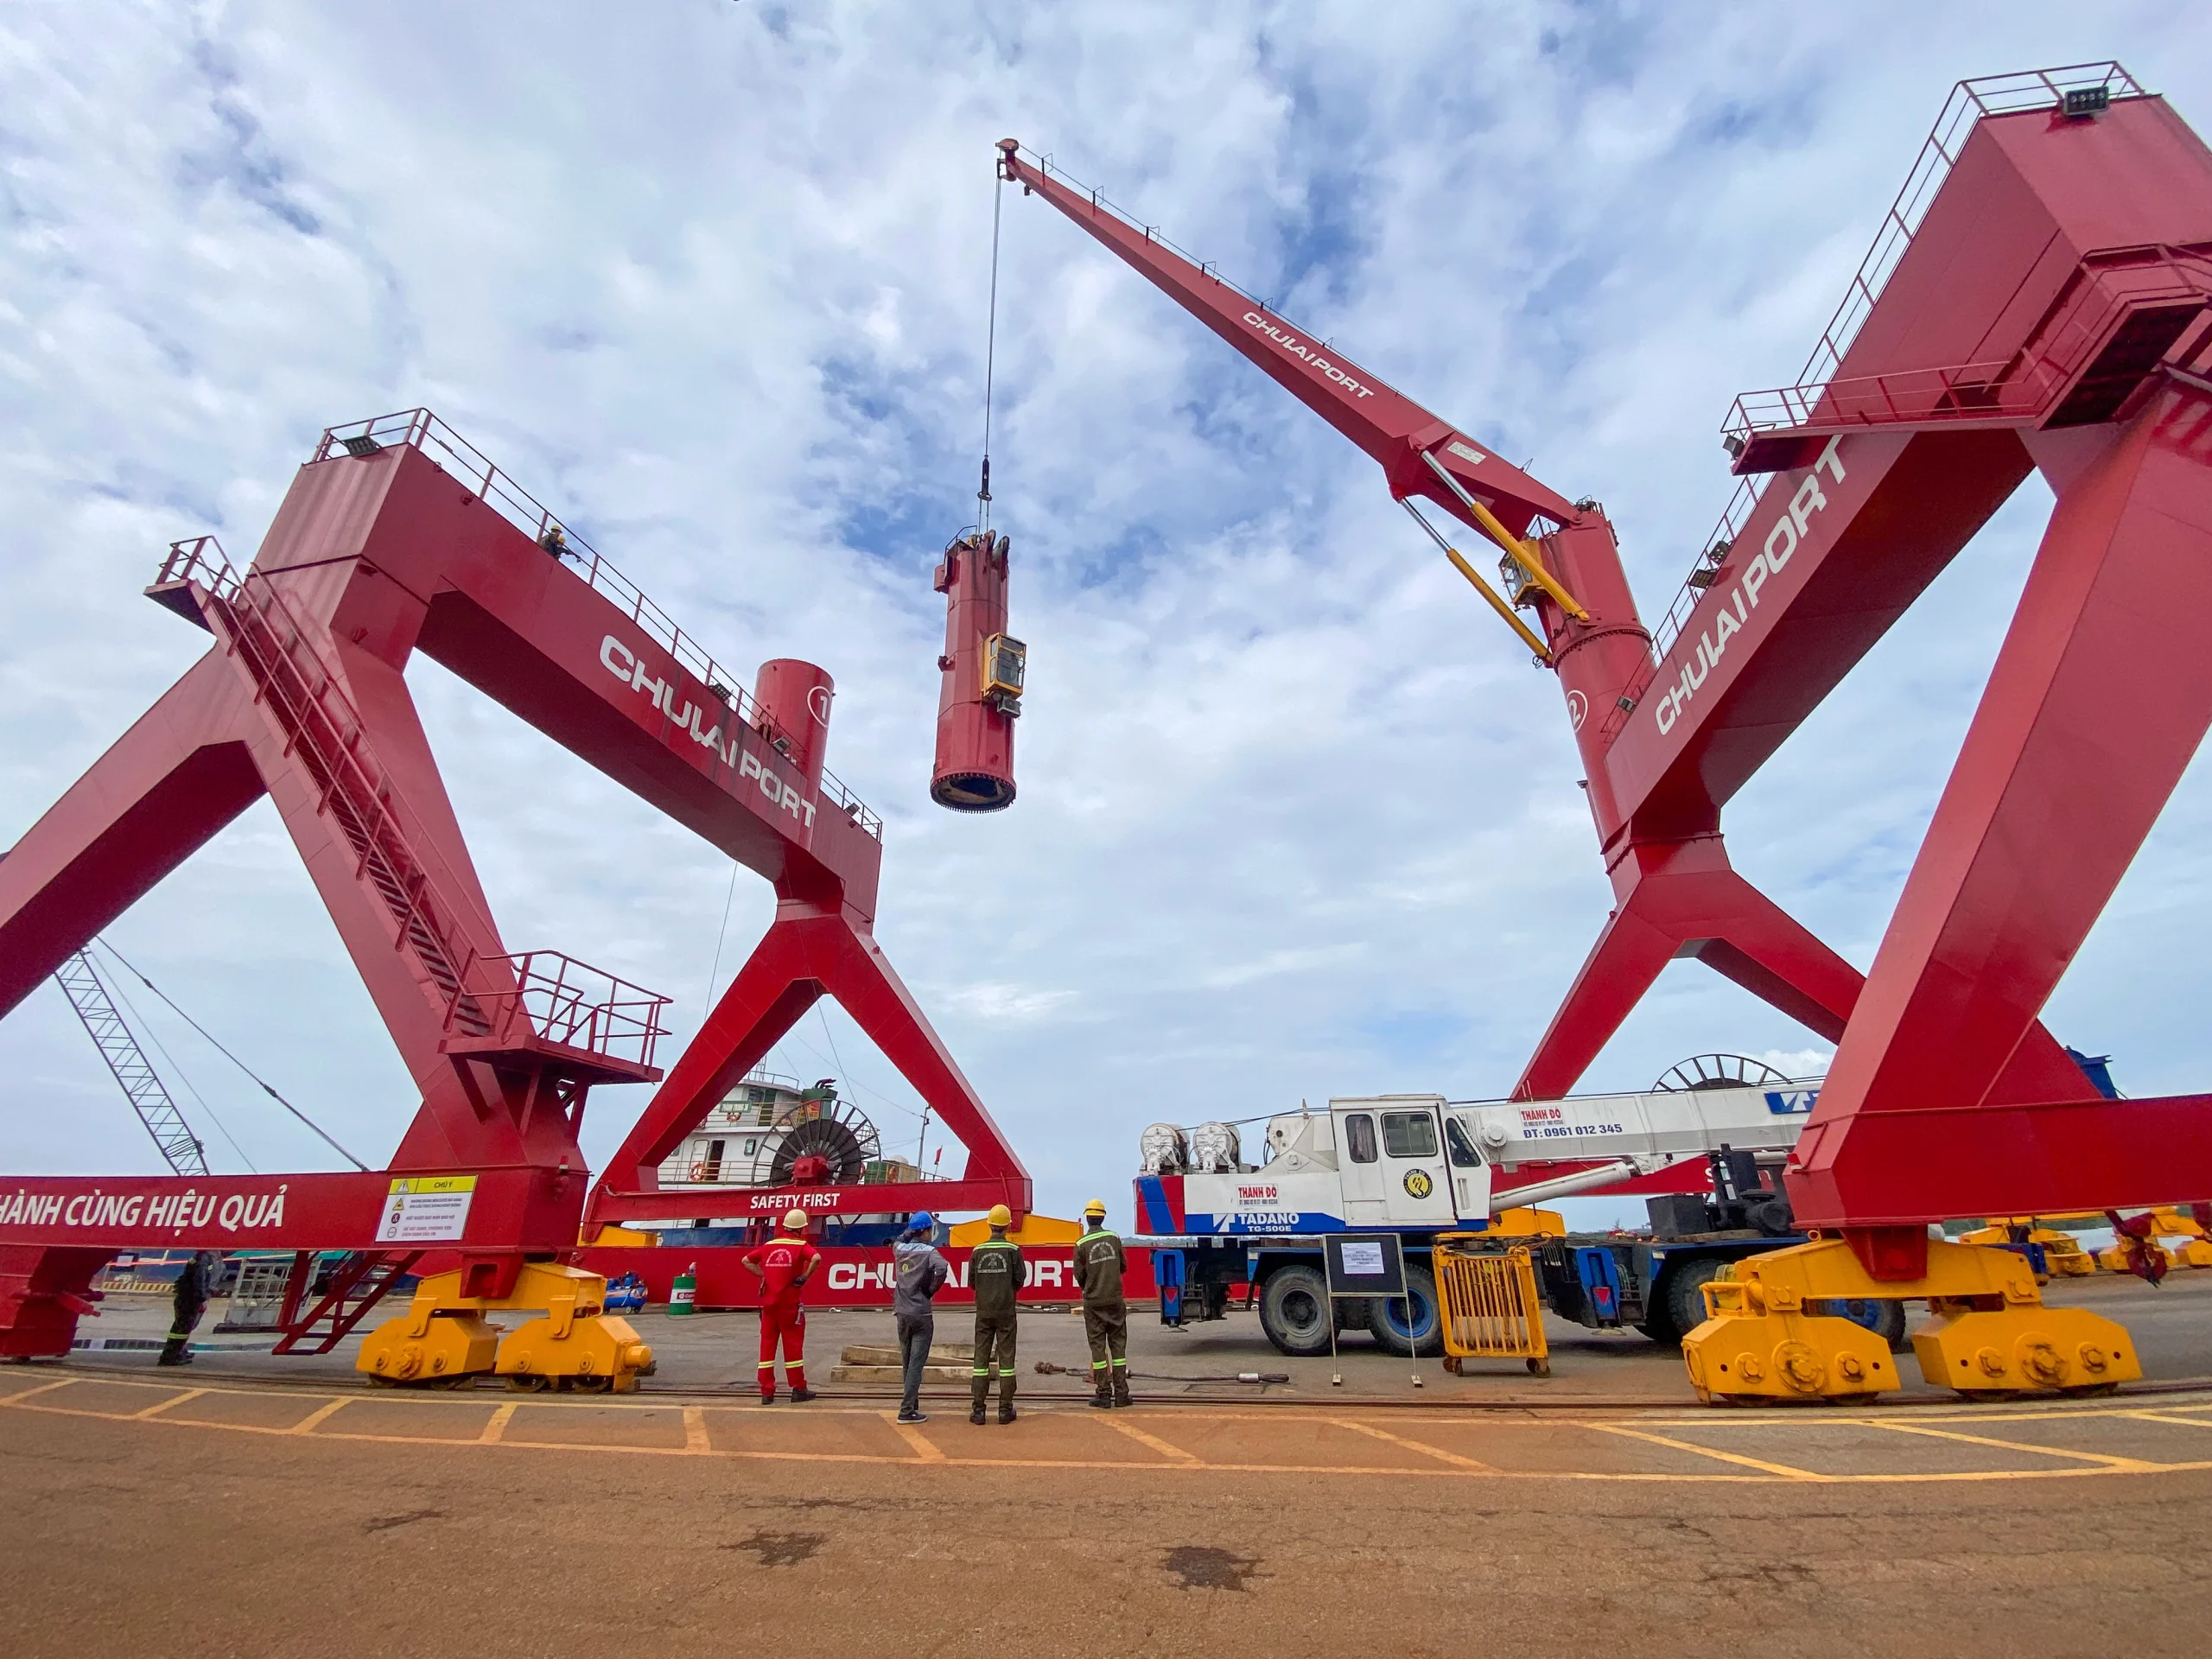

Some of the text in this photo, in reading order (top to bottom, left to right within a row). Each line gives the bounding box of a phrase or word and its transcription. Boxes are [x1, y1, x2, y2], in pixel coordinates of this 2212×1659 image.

[820, 695, 828, 720] 1
[1568, 699, 1581, 728] 2
[1544, 1127, 1573, 1138] 0961
[1575, 1125, 1597, 1135] 012
[1599, 1123, 1624, 1135] 345
[64, 1189, 144, 1227] CÙNG
[143, 1189, 218, 1236] HIỆU
[219, 1184, 288, 1233] QUẢ
[750, 1192, 841, 1210] SAFETY FIRST
[1237, 1213, 1300, 1225] TADANO
